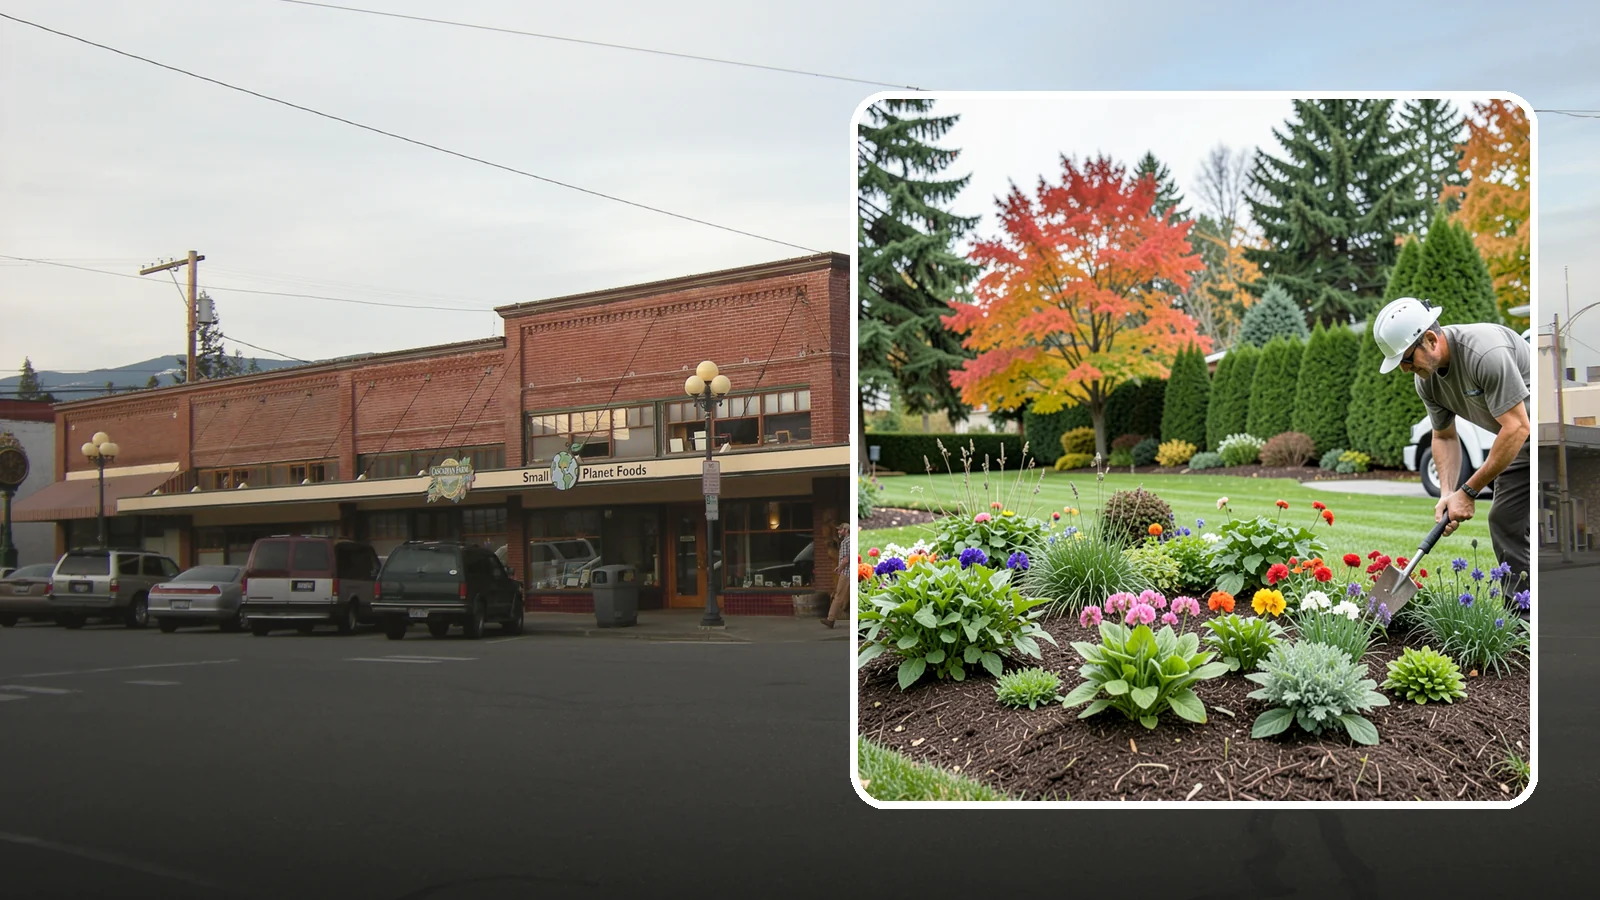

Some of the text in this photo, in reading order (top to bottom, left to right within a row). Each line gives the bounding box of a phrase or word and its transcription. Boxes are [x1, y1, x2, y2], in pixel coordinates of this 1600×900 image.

[523, 464, 647, 483] Small Planet Foods
